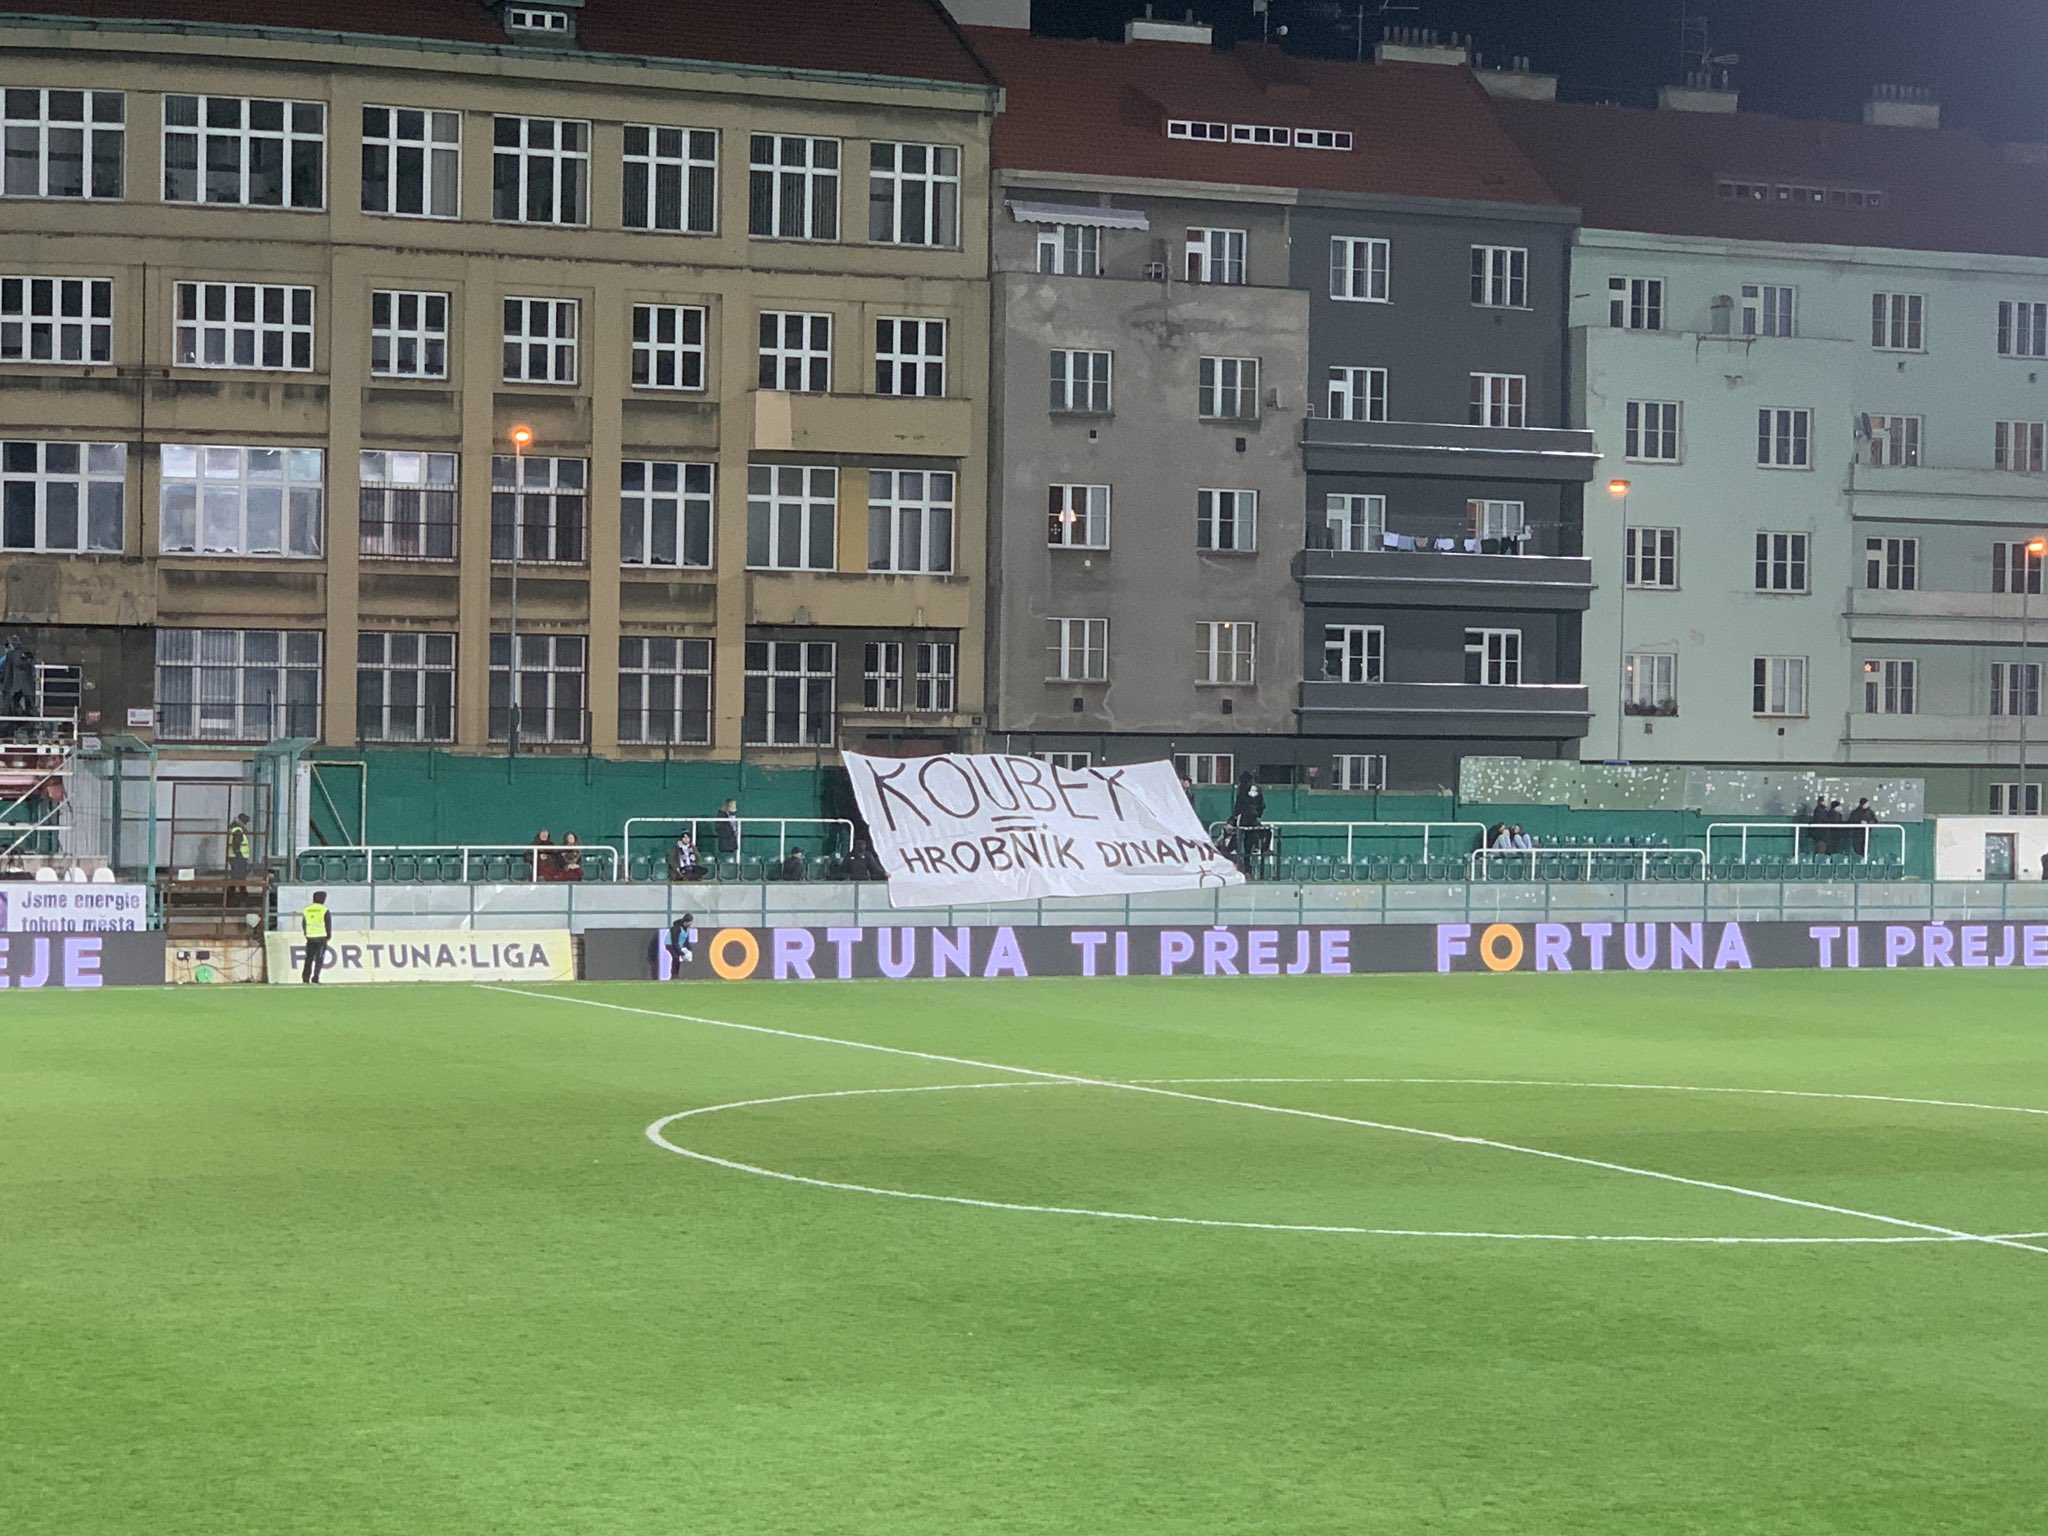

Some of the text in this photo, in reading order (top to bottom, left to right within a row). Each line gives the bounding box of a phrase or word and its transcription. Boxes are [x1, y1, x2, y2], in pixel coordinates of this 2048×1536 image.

[22, 891, 140, 911] Jsme energie
[0, 937, 103, 988] JE
[1071, 930, 1129, 976] TI
[1160, 925, 1351, 976] PŘEJE
[1437, 921, 2048, 972] FORTUNA TI PŘEJE
